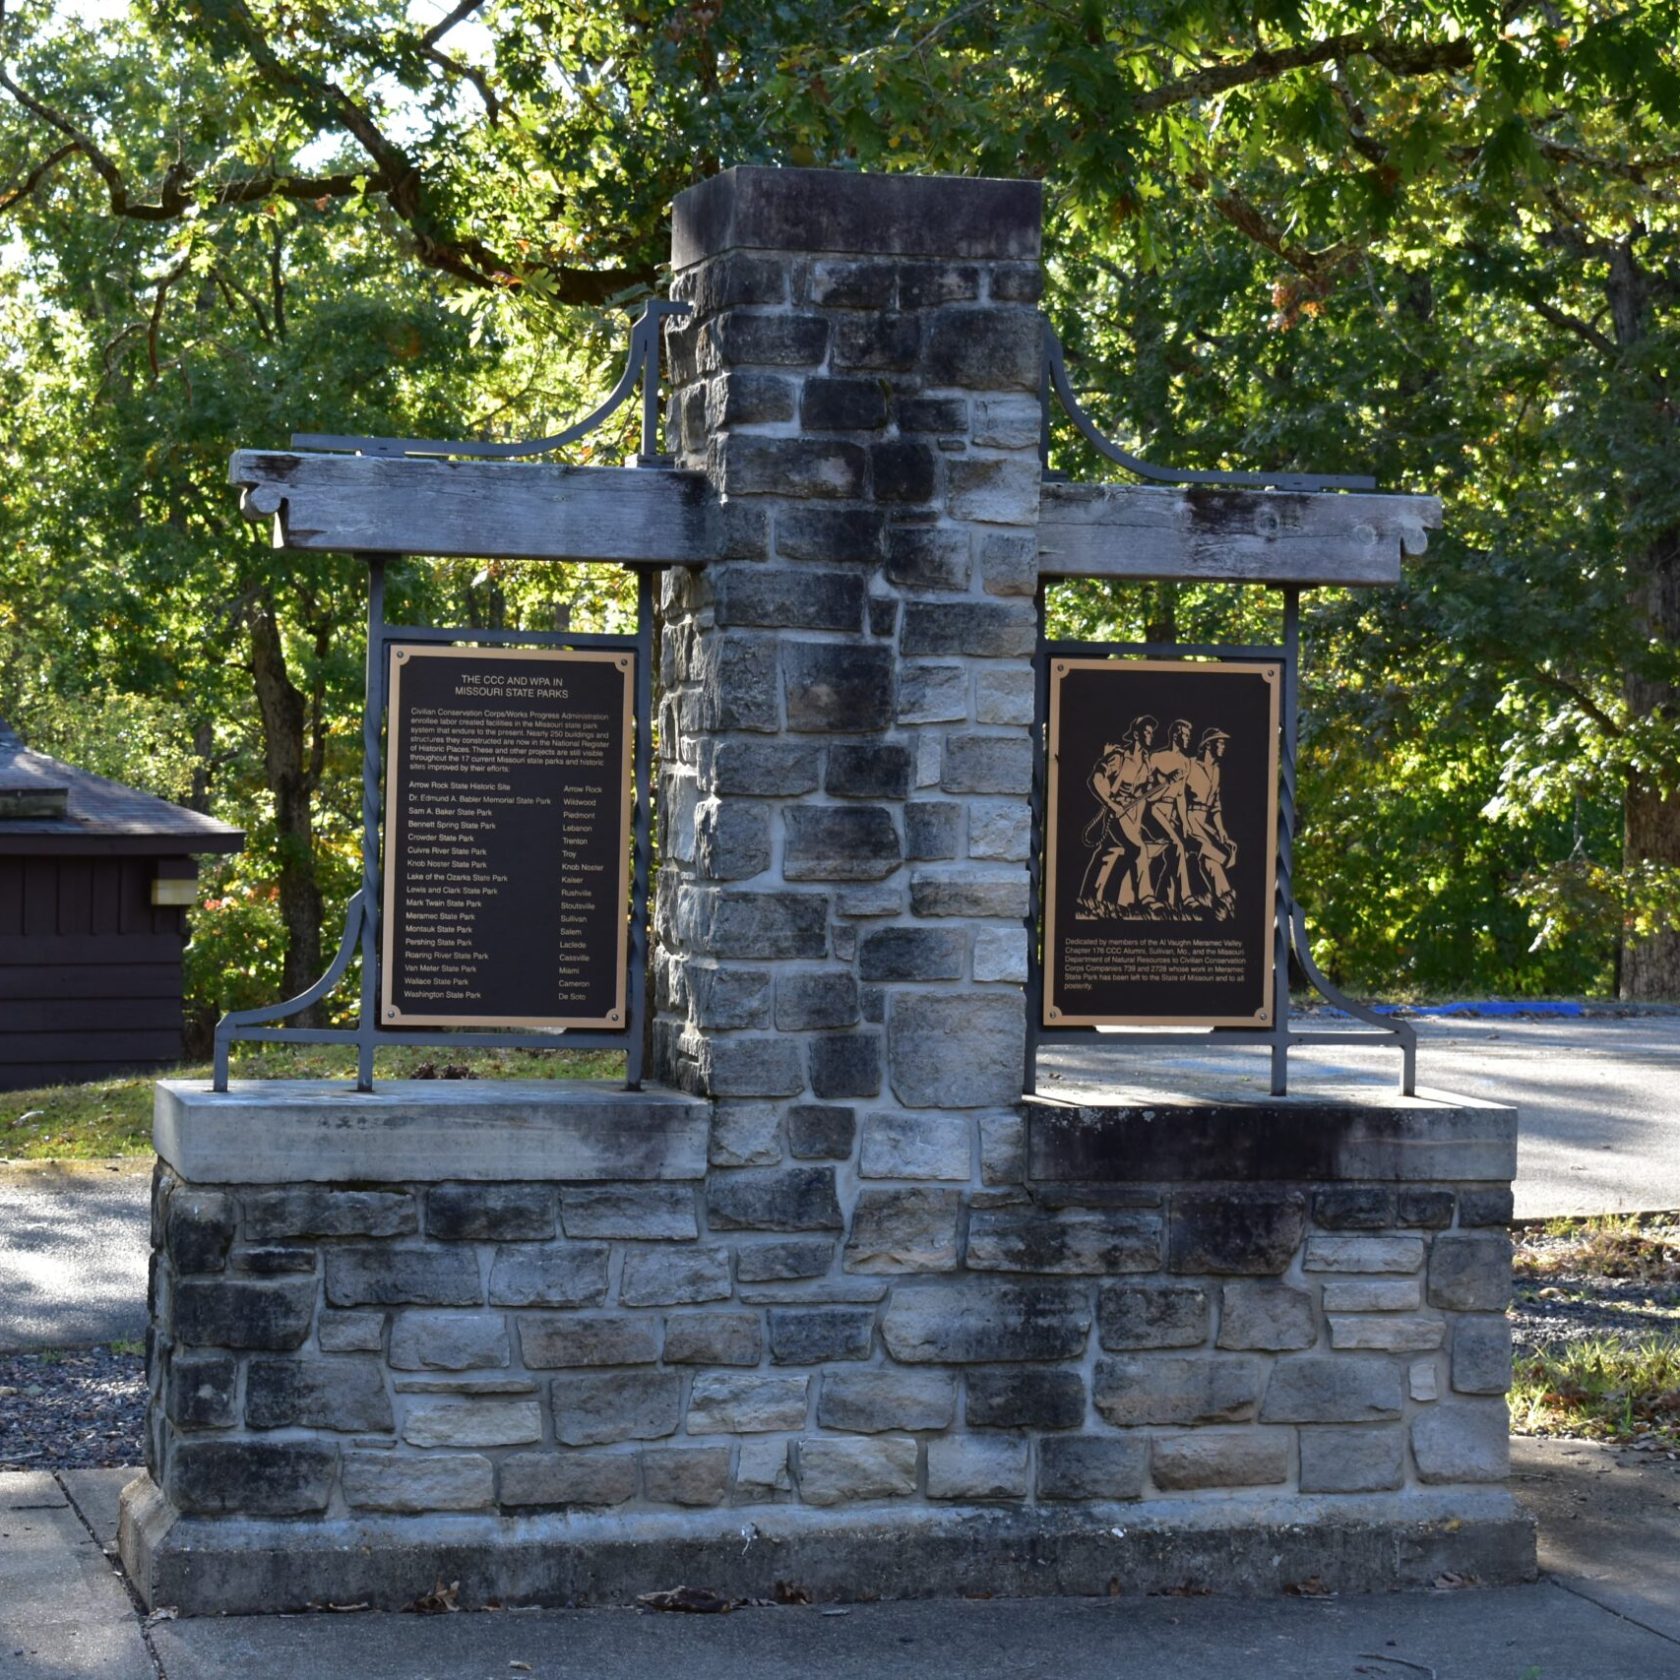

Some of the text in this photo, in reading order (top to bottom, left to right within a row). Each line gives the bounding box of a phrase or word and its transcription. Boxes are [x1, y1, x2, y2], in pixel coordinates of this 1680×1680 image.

[461, 675, 563, 686] THE CCC AND WPA IN
[455, 686, 569, 699] MISSOURI STATE PARKS
[411, 707, 436, 715] Civilian
[437, 708, 483, 717] Conservation
[529, 711, 560, 720] Progress
[561, 712, 610, 720] Administration
[419, 744, 444, 752] Historic
[472, 746, 494, 754] These
[528, 748, 555, 757] projects
[410, 753, 447, 763] throughout
[448, 754, 459, 762] the
[496, 756, 525, 764] Missouri
[545, 757, 564, 766] parks
[580, 758, 604, 766] historic
[410, 762, 426, 770] sites
[427, 763, 459, 773] improved
[460, 764, 469, 773] by
[470, 764, 486, 772] their
[431, 781, 449, 789] Rock
[470, 782, 496, 790] Historic
[564, 785, 603, 793] Arrow Rock
[420, 794, 449, 802] Edmund
[459, 795, 482, 803] Babler
[483, 796, 515, 804] Memorial
[535, 797, 552, 805] Park
[563, 798, 596, 806] Wildwood
[408, 807, 425, 815] Sam
[457, 808, 475, 816] State
[476, 808, 493, 816] Park
[563, 811, 595, 819] Piedmont
[408, 820, 435, 828] Bennett
[436, 821, 459, 830] Spring
[460, 821, 479, 829] State
[563, 824, 592, 832] Lebanon
[408, 833, 474, 842] Crowder State Park
[562, 837, 588, 845] Trenton
[408, 846, 430, 854] Cuivre
[451, 847, 470, 855] State
[562, 850, 576, 859] Troy
[407, 859, 426, 867] Knob
[427, 860, 450, 868] Noster
[451, 860, 470, 868] State
[562, 863, 580, 871] Knob
[407, 872, 424, 880] Lake
[446, 873, 471, 881] Ozarks
[492, 874, 508, 882] Park
[561, 876, 584, 884] Kaiser
[428, 886, 441, 894] and
[442, 886, 461, 894] Clark
[482, 887, 498, 895] Park
[561, 889, 592, 897] Rushville
[406, 898, 424, 906] Mark
[425, 899, 445, 907] Twain
[561, 902, 596, 910] Stoutsville
[406, 912, 438, 920] Meramec
[439, 912, 458, 920] State
[560, 915, 587, 923] Sullivan
[405, 938, 436, 947] Pershing
[560, 941, 587, 949] Laclede
[405, 951, 432, 960] Roaring
[434, 951, 452, 959] River
[473, 952, 489, 960] Park
[559, 954, 590, 962] Cassville
[404, 964, 418, 972] Van
[420, 964, 440, 972] Meter
[559, 966, 580, 974] Miami
[404, 977, 432, 985] Wallace
[404, 990, 444, 1000] Washington
[465, 991, 482, 999] Park
